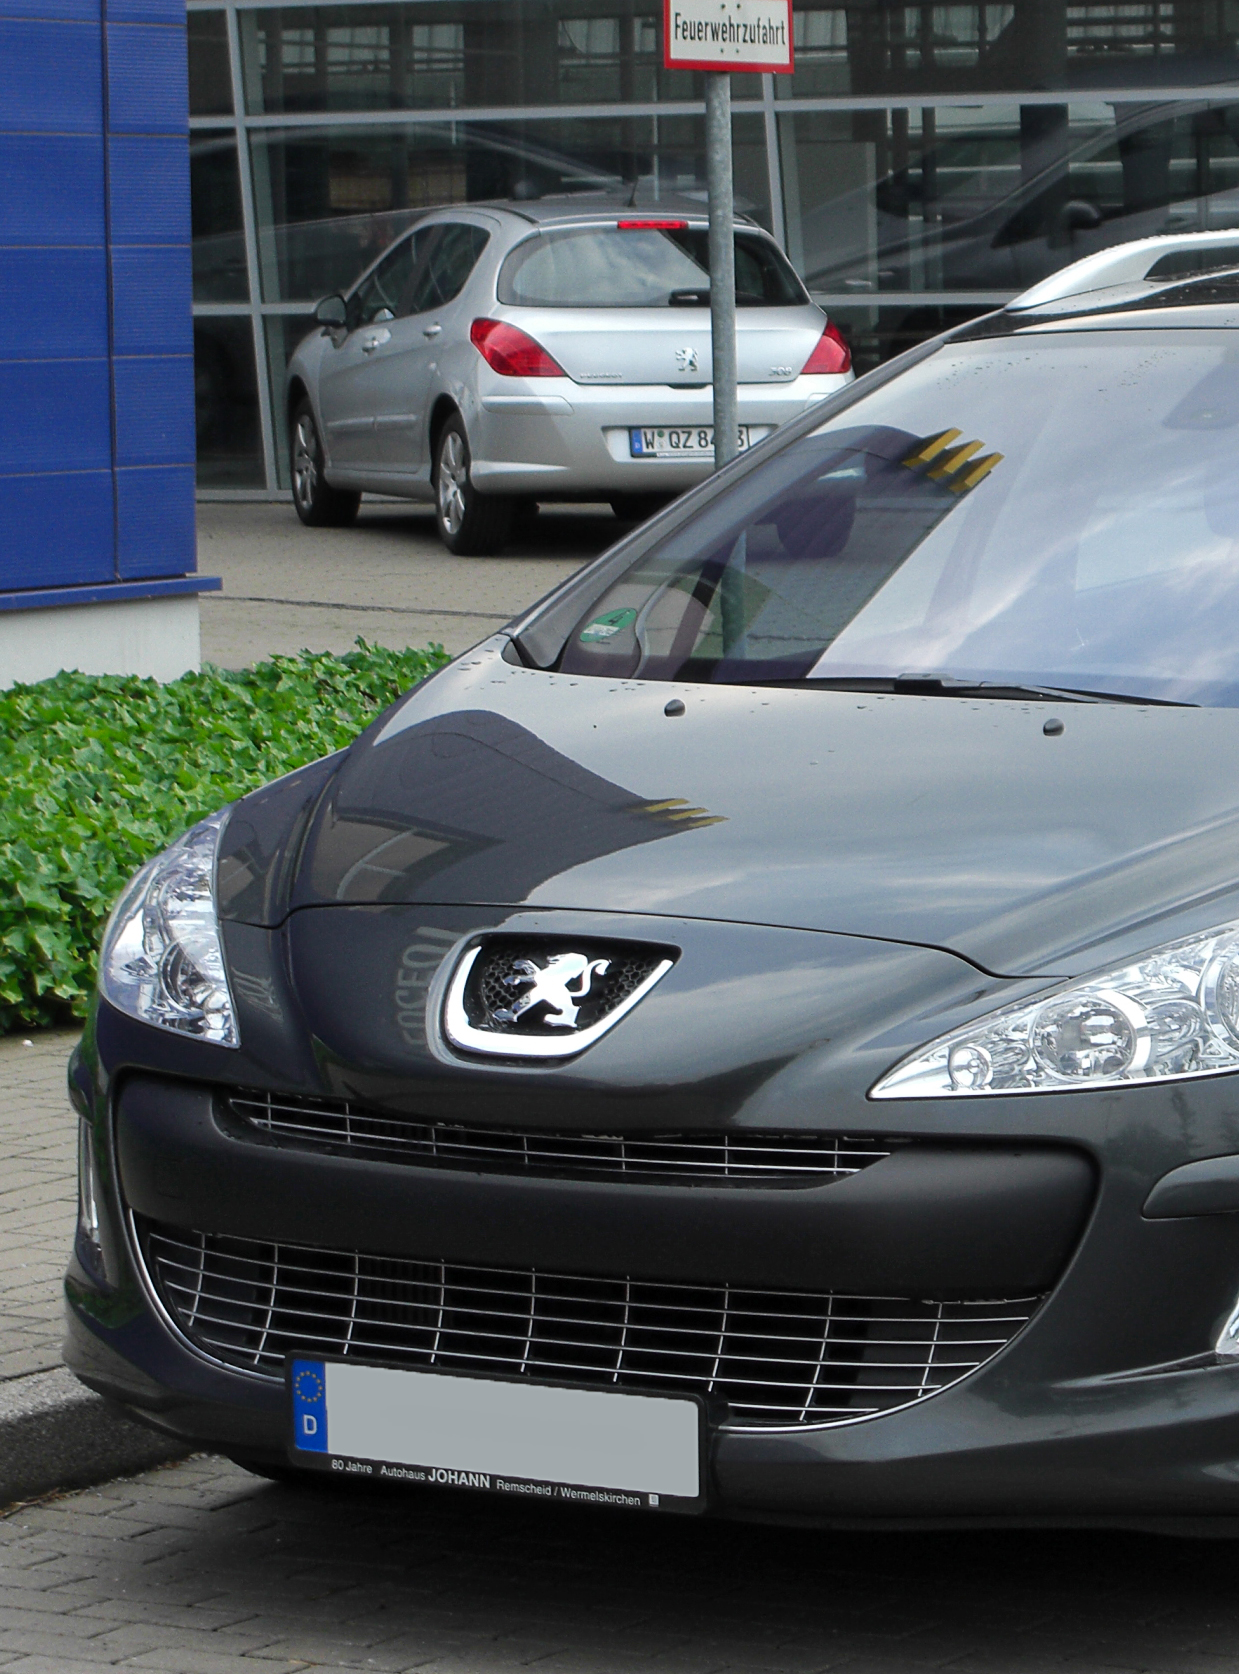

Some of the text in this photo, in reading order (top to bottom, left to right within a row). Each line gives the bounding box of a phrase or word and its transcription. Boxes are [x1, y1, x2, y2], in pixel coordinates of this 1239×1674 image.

[674, 12, 787, 46] Feuerwehrzufahrt
[643, 430, 655, 449] W
[669, 430, 695, 449] QZ
[303, 1414, 318, 1436] D
[331, 1459, 344, 1470] 80
[345, 1461, 373, 1474] Jahre
[380, 1465, 426, 1481] Autohaus
[427, 1468, 491, 1489] JOHANN
[496, 1479, 552, 1496] Remscheid
[560, 1487, 642, 1506] Wermelskirchen
